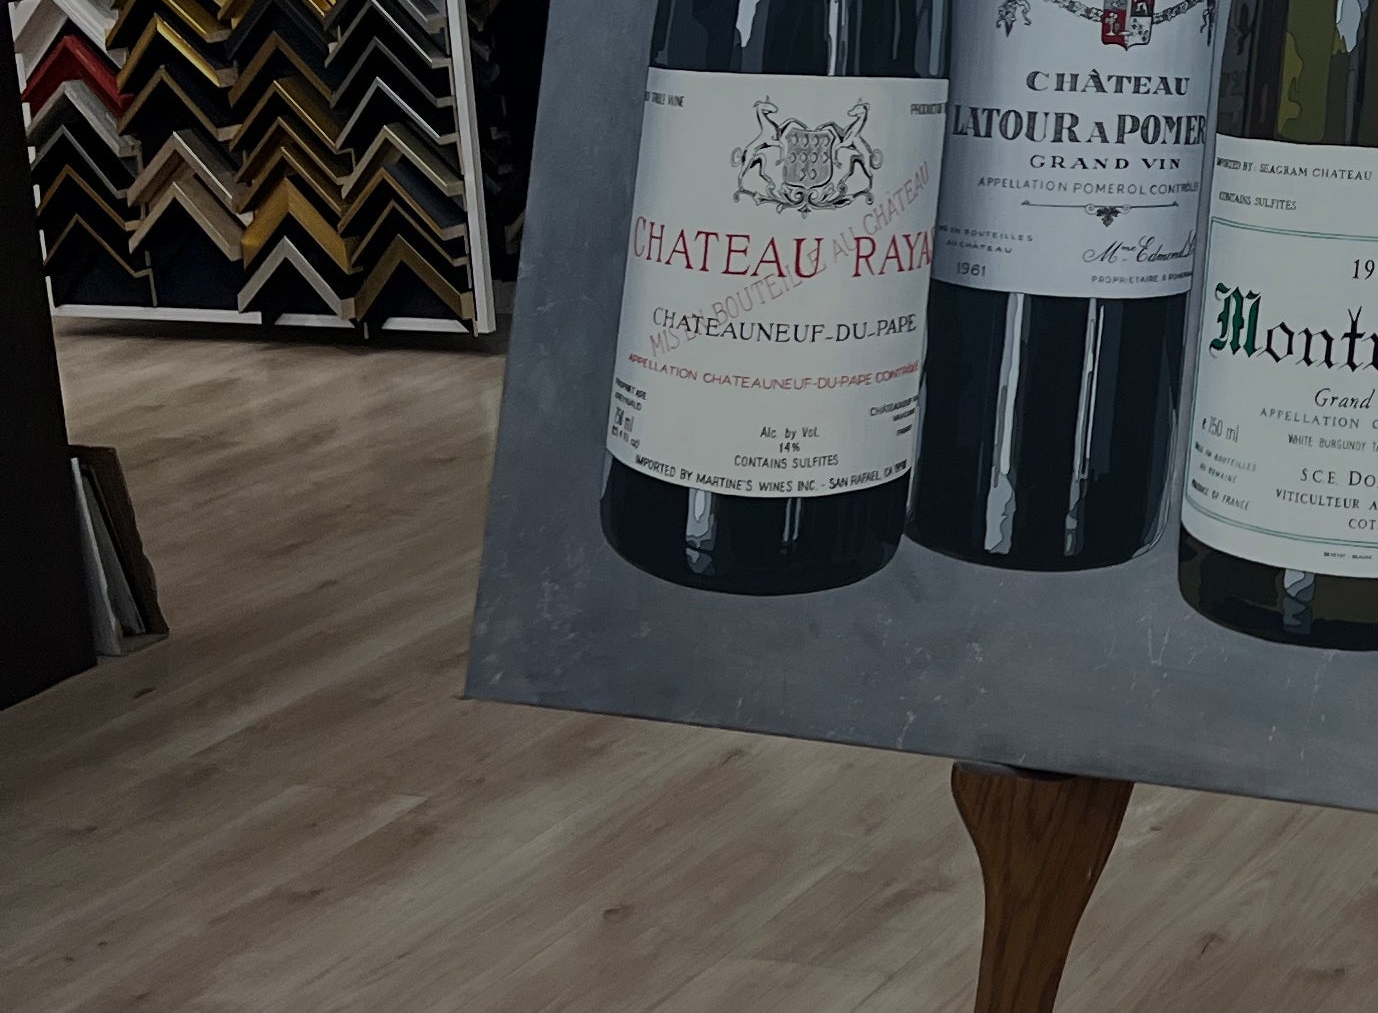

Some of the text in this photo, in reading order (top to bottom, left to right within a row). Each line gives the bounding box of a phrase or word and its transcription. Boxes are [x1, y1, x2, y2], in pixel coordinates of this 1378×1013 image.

[952, 104, 1080, 144] LATOUR
[1030, 154, 1181, 170] GRAND VIN
[1243, 161, 1253, 172] BY
[1260, 163, 1308, 177] SEAGRAM
[1312, 168, 1373, 182] CHATEAU
[978, 176, 1068, 193] APPELLATION
[1073, 182, 1146, 195] POMEROL
[1254, 196, 1297, 211] SULFITES
[633, 216, 824, 278] CHATEAU
[956, 262, 986, 277] 1961
[653, 307, 917, 343] CHATEAUNEUF-DU-PAPE
[628, 353, 698, 381] APPELLATION
[1314, 387, 1375, 411] Grand
[1260, 406, 1361, 430] APPELLATION
[784, 428, 797, 440] by
[1225, 424, 1240, 443] ml
[1287, 434, 1314, 447] WHITE
[1319, 437, 1367, 453] BURGUNDY
[779, 442, 800, 453] 14%
[734, 453, 839, 469] CONTAINS SULFITES
[635, 454, 676, 478] IMPORTED
[680, 468, 693, 480] BY
[759, 480, 793, 493] WINES
[829, 476, 848, 490] SAN
[1276, 488, 1360, 509] VITICULTEUR
